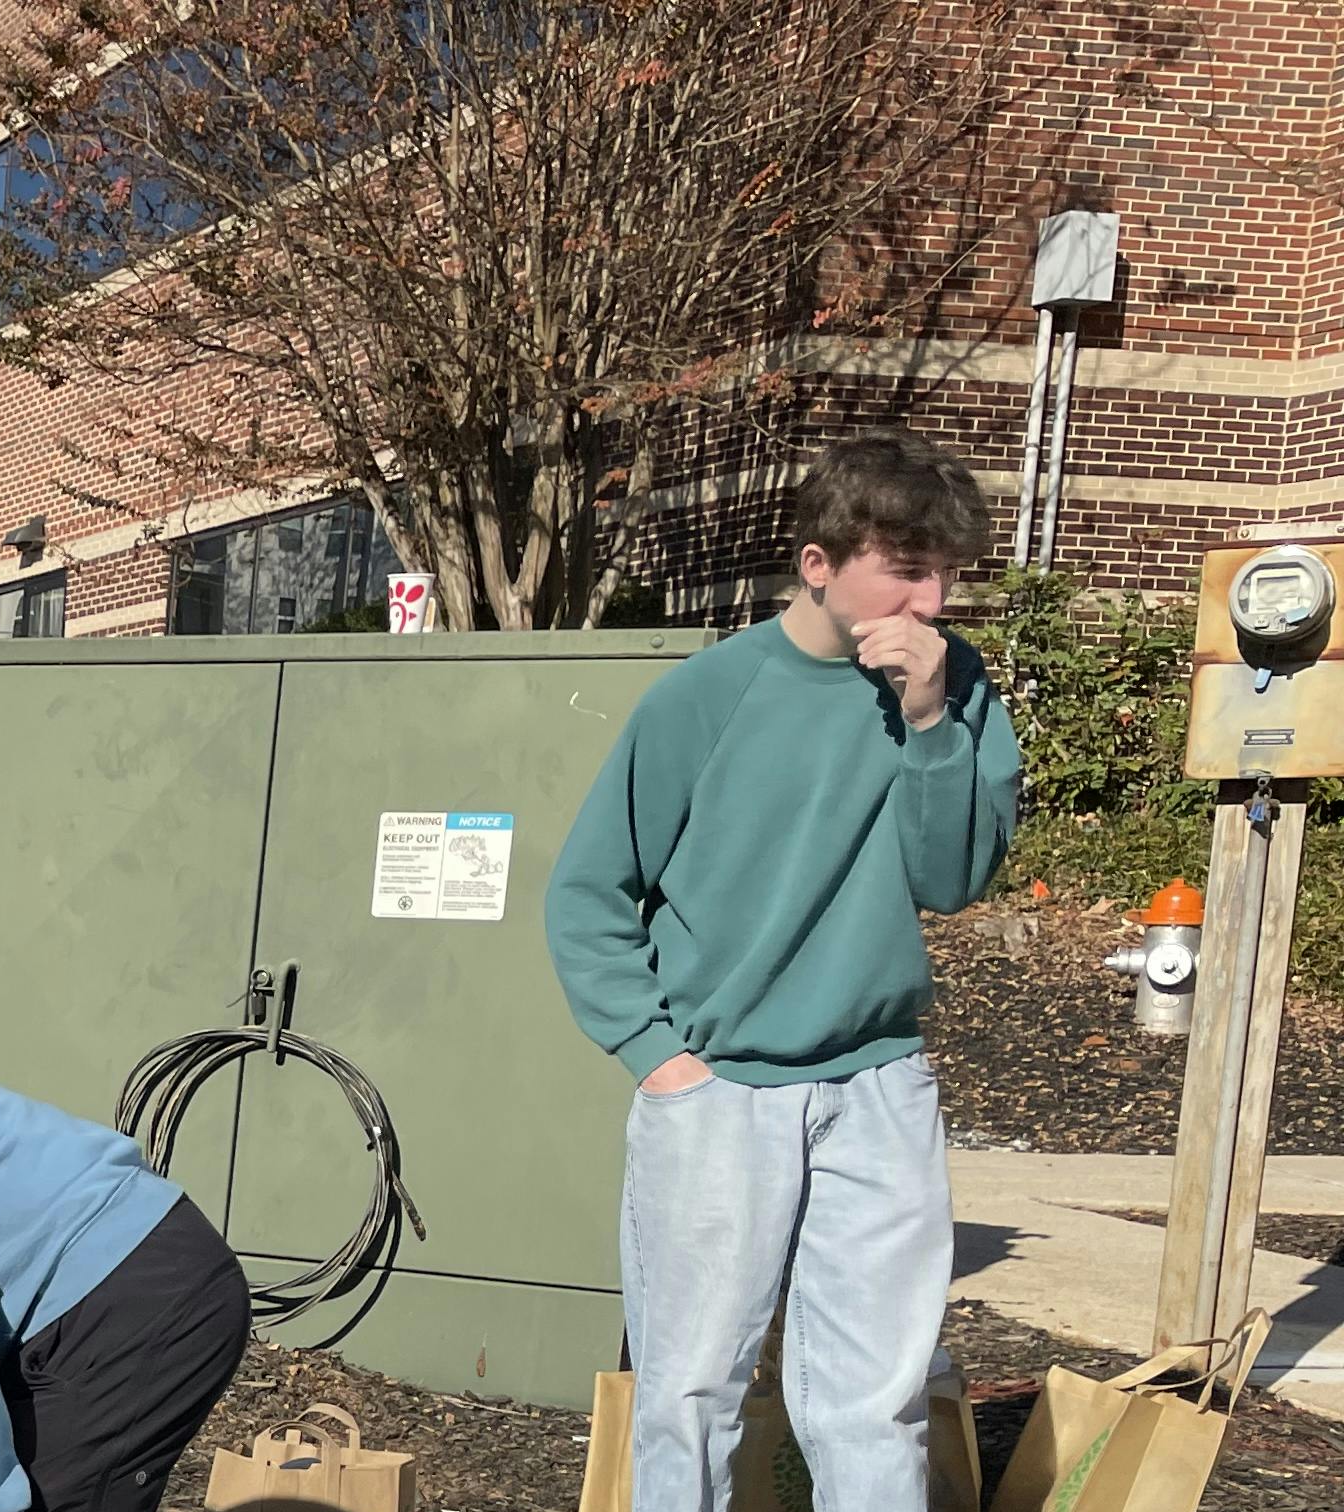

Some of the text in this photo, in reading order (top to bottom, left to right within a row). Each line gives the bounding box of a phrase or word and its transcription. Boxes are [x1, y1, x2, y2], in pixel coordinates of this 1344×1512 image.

[397, 816, 442, 826] WARNING
[459, 817, 502, 828] NOTICE
[383, 833, 440, 844] KEEP OUT
